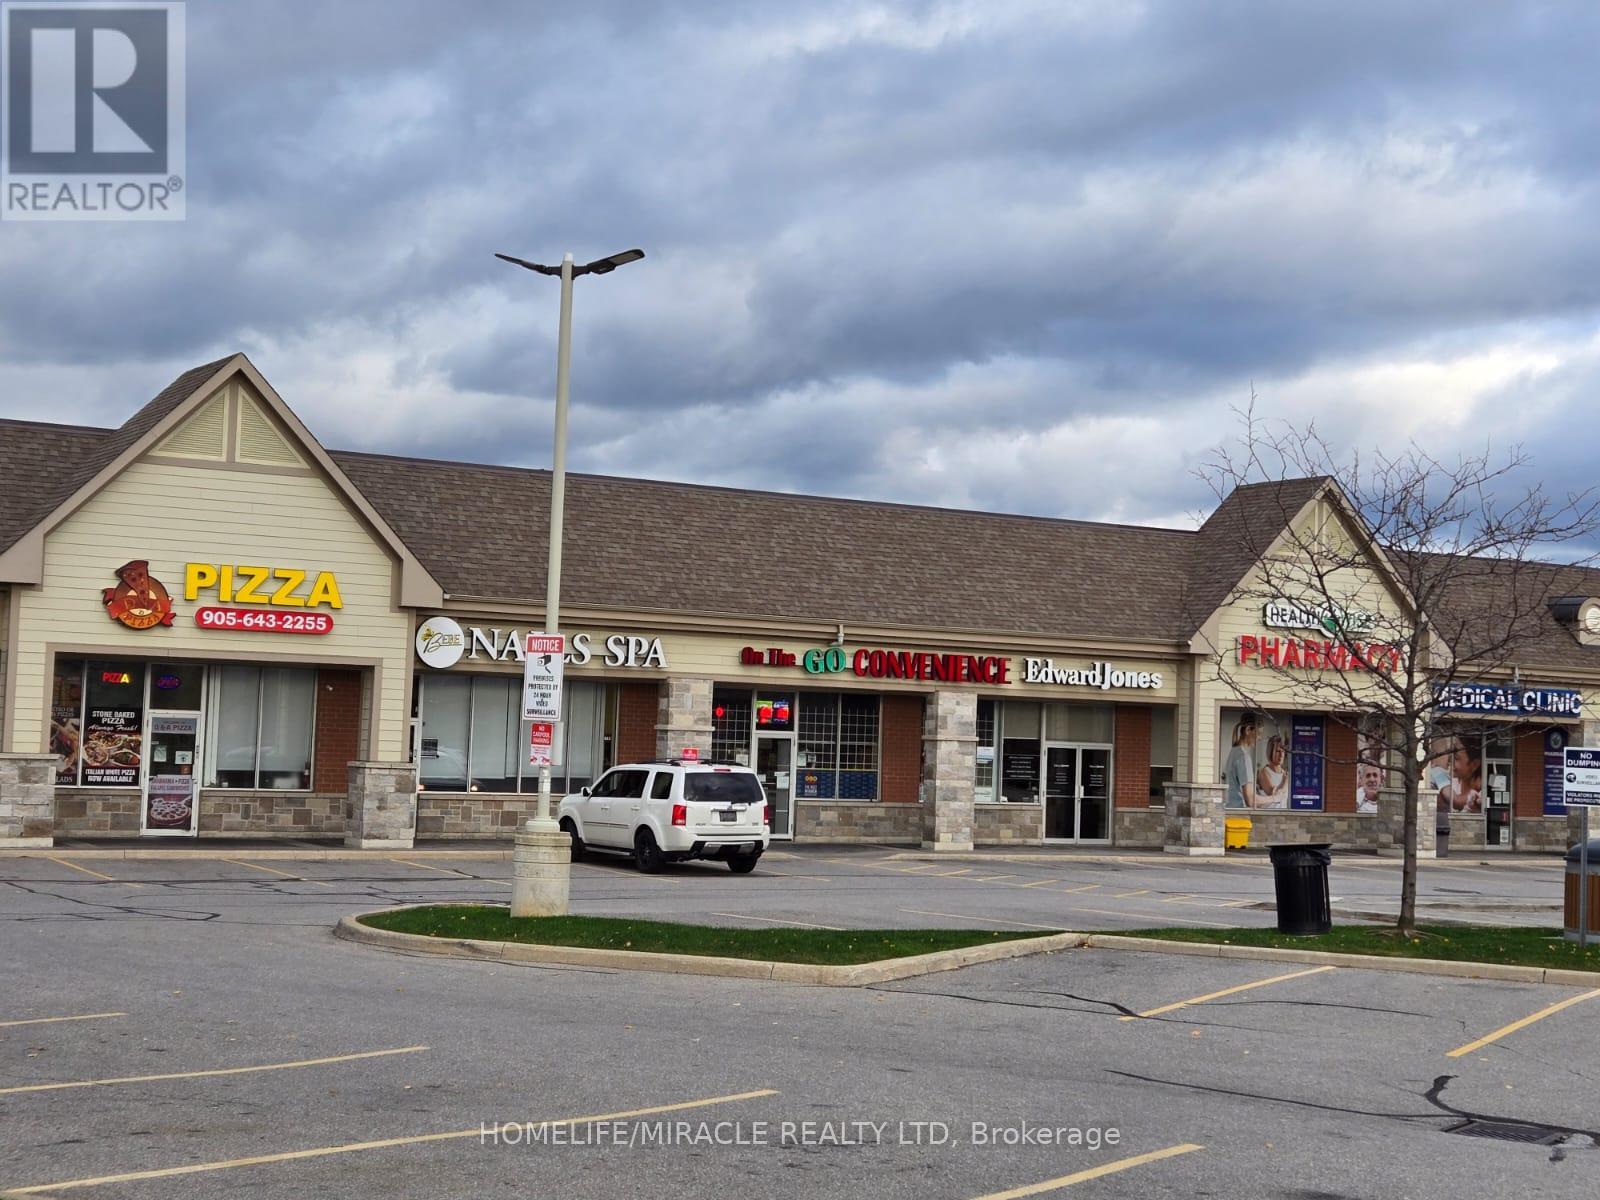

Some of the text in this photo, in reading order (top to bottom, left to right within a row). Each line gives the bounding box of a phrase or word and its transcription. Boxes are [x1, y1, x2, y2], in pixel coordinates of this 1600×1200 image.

[184, 562, 343, 610] PIZZA
[202, 611, 327, 631] 905-643-2255
[467, 627, 670, 669] NAS SPA
[531, 639, 560, 652] NOTICE
[1238, 634, 1401, 673] PHARMACY
[740, 647, 1012, 685] On The GO CONVENIENCE
[102, 672, 130, 683] PIZZA
[528, 683, 552, 691] PROTECTED
[1522, 691, 1584, 714] CLINIC
[92, 710, 135, 719] STONE BAKED
[526, 708, 557, 716] SURVEILLANCE
[101, 717, 126, 725] PIZZA
[1580, 752, 1593, 760] NO
